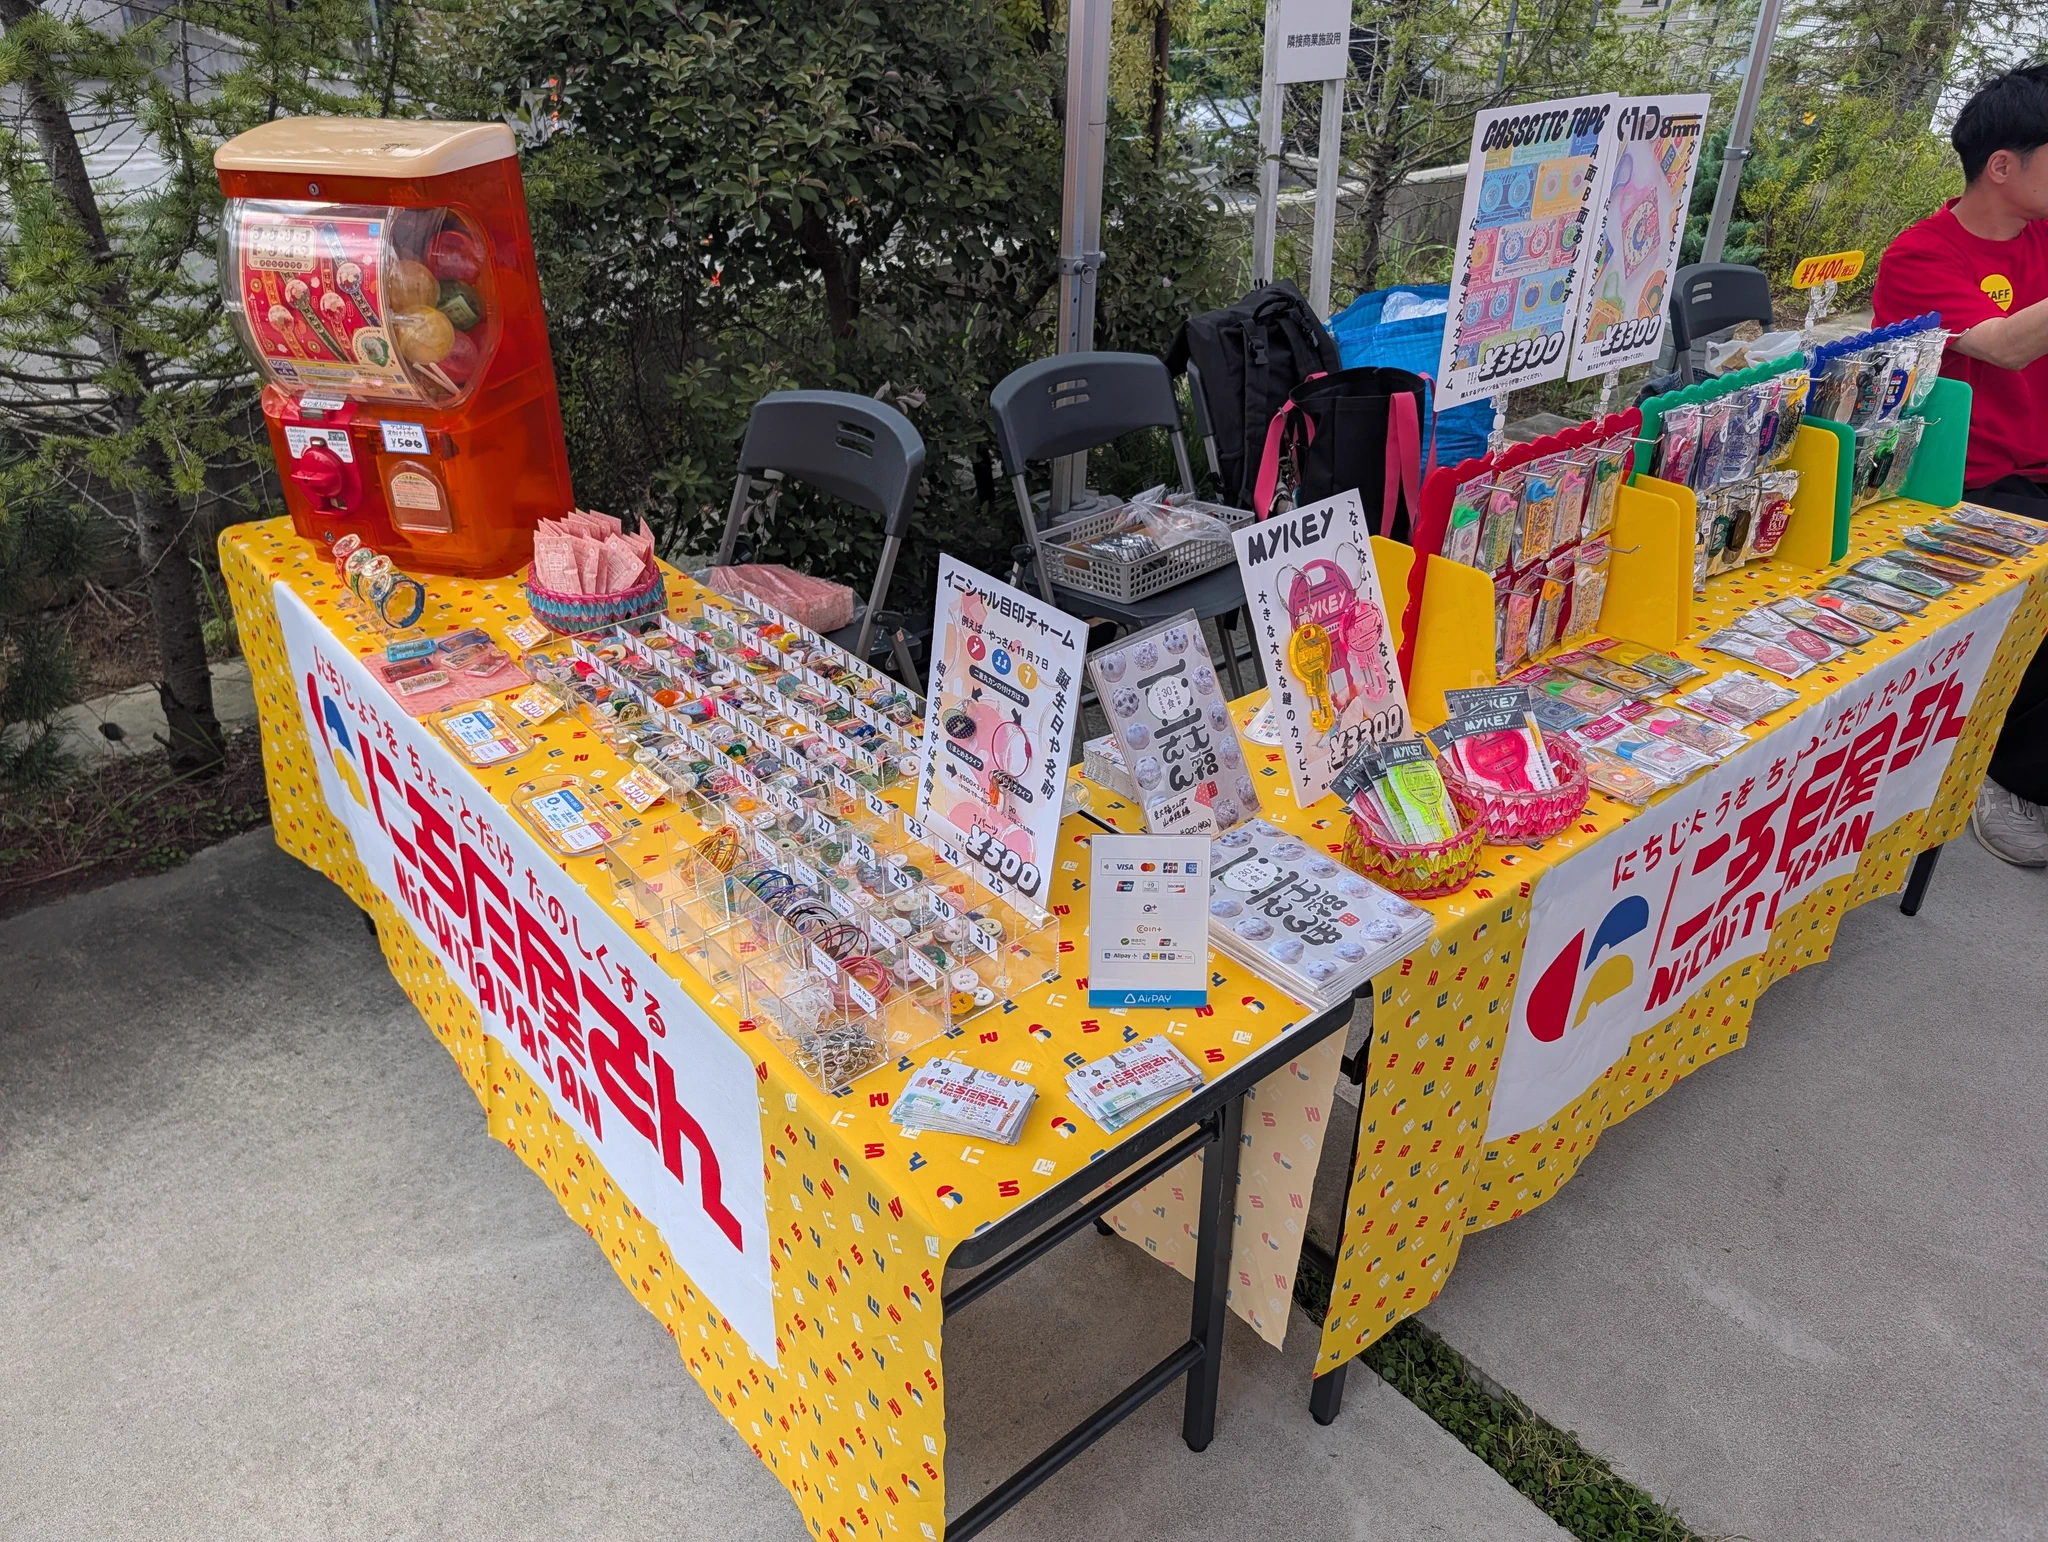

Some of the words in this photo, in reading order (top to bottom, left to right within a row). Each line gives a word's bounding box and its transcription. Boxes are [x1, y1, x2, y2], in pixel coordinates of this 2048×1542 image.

[1481, 109, 1569, 152] CASSETTE
[1566, 104, 1611, 140] TAPE
[1600, 314, 1661, 357] ¥3300
[1478, 331, 1565, 382] ¥3300
[391, 437, 423, 449] ¥500
[1248, 507, 1334, 567] MYKEY
[944, 570, 1075, 650] イニシャル目印チャーム
[814, 676, 819, 688] 1
[1258, 590, 1312, 788] 大きな大きな鍵のカラビナ
[770, 691, 777, 703] 6
[836, 690, 844, 704] 2
[722, 704, 733, 720] 11
[792, 705, 799, 717] 7
[861, 706, 867, 718] 3
[673, 719, 684, 736] 16
[744, 720, 755, 737] 12
[815, 721, 822, 734] 8
[885, 722, 892, 735] 4
[1464, 714, 1512, 732] MYKEY
[695, 735, 705, 750] 17
[839, 737, 845, 749] 9
[910, 737, 917, 749] 5
[1040, 667, 1072, 800] 誕生日や名前
[1329, 704, 1403, 771] ¥3300
[766, 735, 777, 752] 13
[717, 752, 729, 772] 18
[790, 752, 802, 770] 14
[862, 752, 873, 766] 10
[741, 770, 752, 787] 19
[839, 773, 852, 792] 21
[621, 781, 651, 804] ¥500
[766, 789, 779, 807] 20
[786, 791, 799, 810] 26
[870, 795, 883, 814] 22
[818, 815, 830, 834] 27
[909, 818, 922, 839] 23
[1613, 775, 1756, 891] にちじょうを
[314, 646, 400, 759] にちじょうを
[406, 744, 516, 877] ちょっとだけ
[526, 869, 667, 1040] たのしくする
[856, 840, 870, 861] 28
[944, 844, 958, 866] 24
[965, 824, 1041, 898] ¥500
[1116, 863, 1134, 871] VISA
[893, 867, 908, 888] 29
[988, 873, 1004, 894] 25
[934, 896, 949, 918] 30
[976, 928, 991, 950] 31
[357, 729, 743, 1254] にちた屋さん
